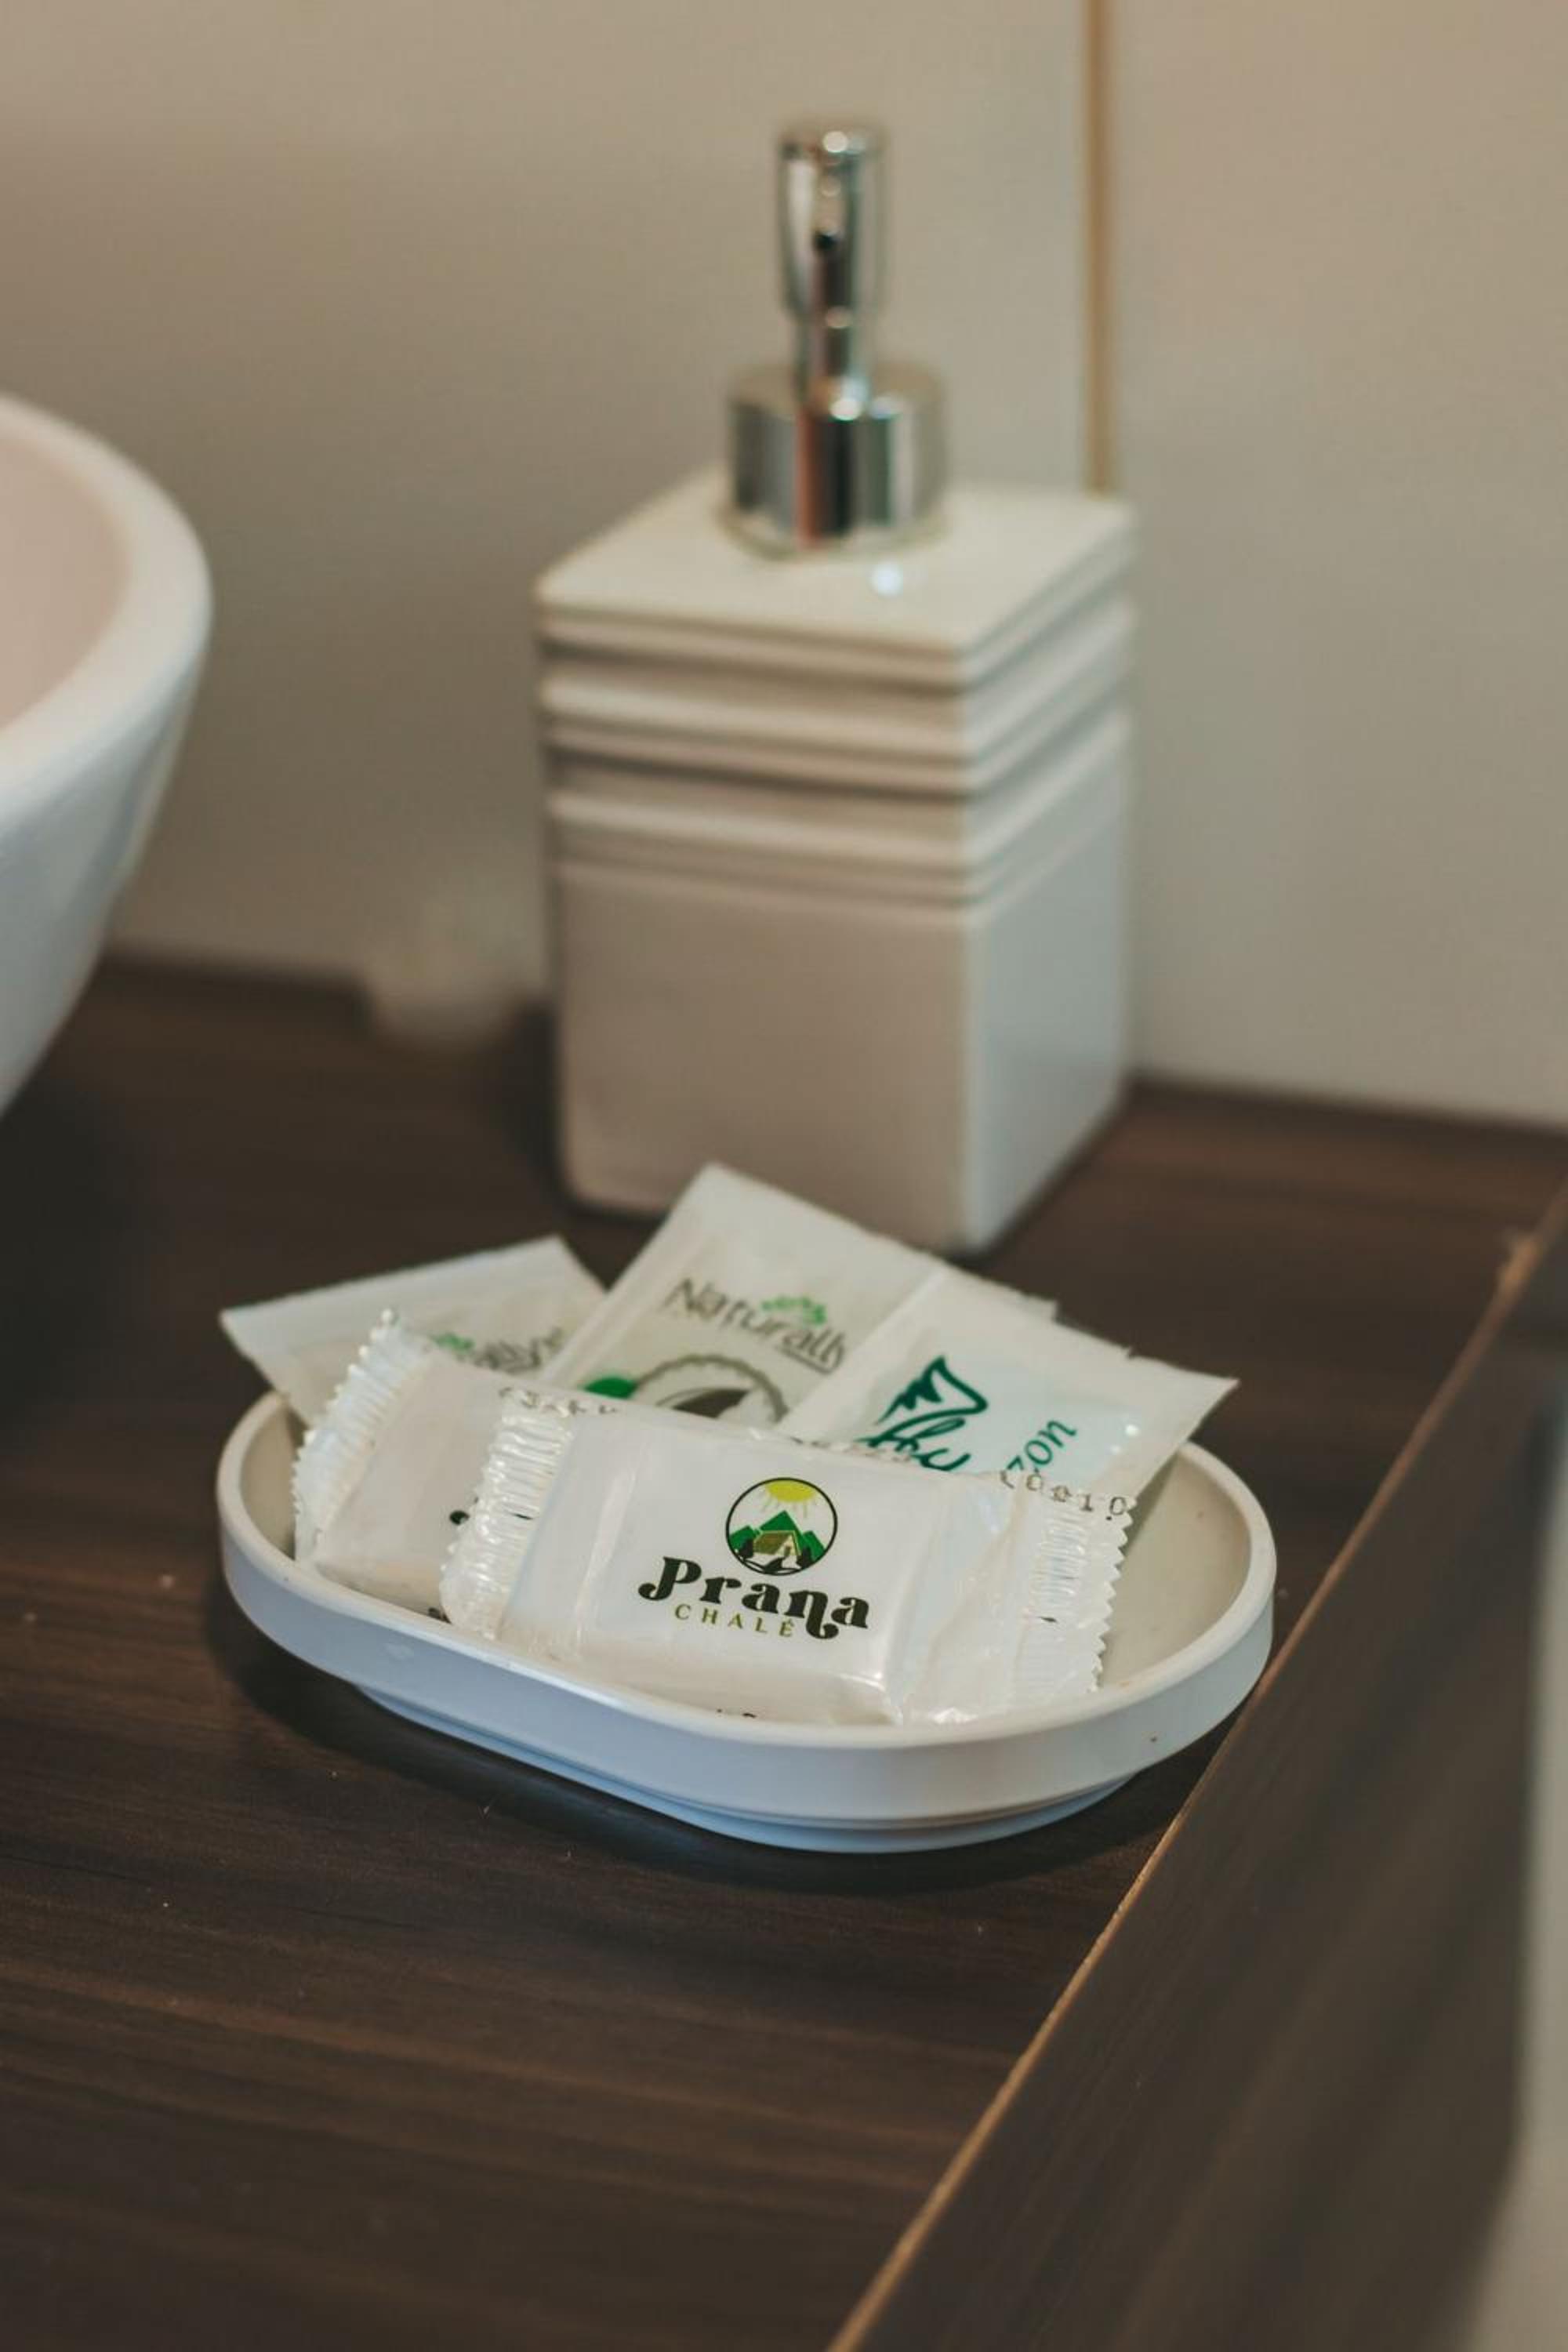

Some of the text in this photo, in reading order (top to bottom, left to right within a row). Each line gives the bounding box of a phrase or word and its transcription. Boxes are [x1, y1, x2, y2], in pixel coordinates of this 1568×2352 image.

[660, 1278, 847, 1376] Naturally
[637, 1555, 870, 1640] Prana
[673, 1603, 795, 1638] CHALÉ
